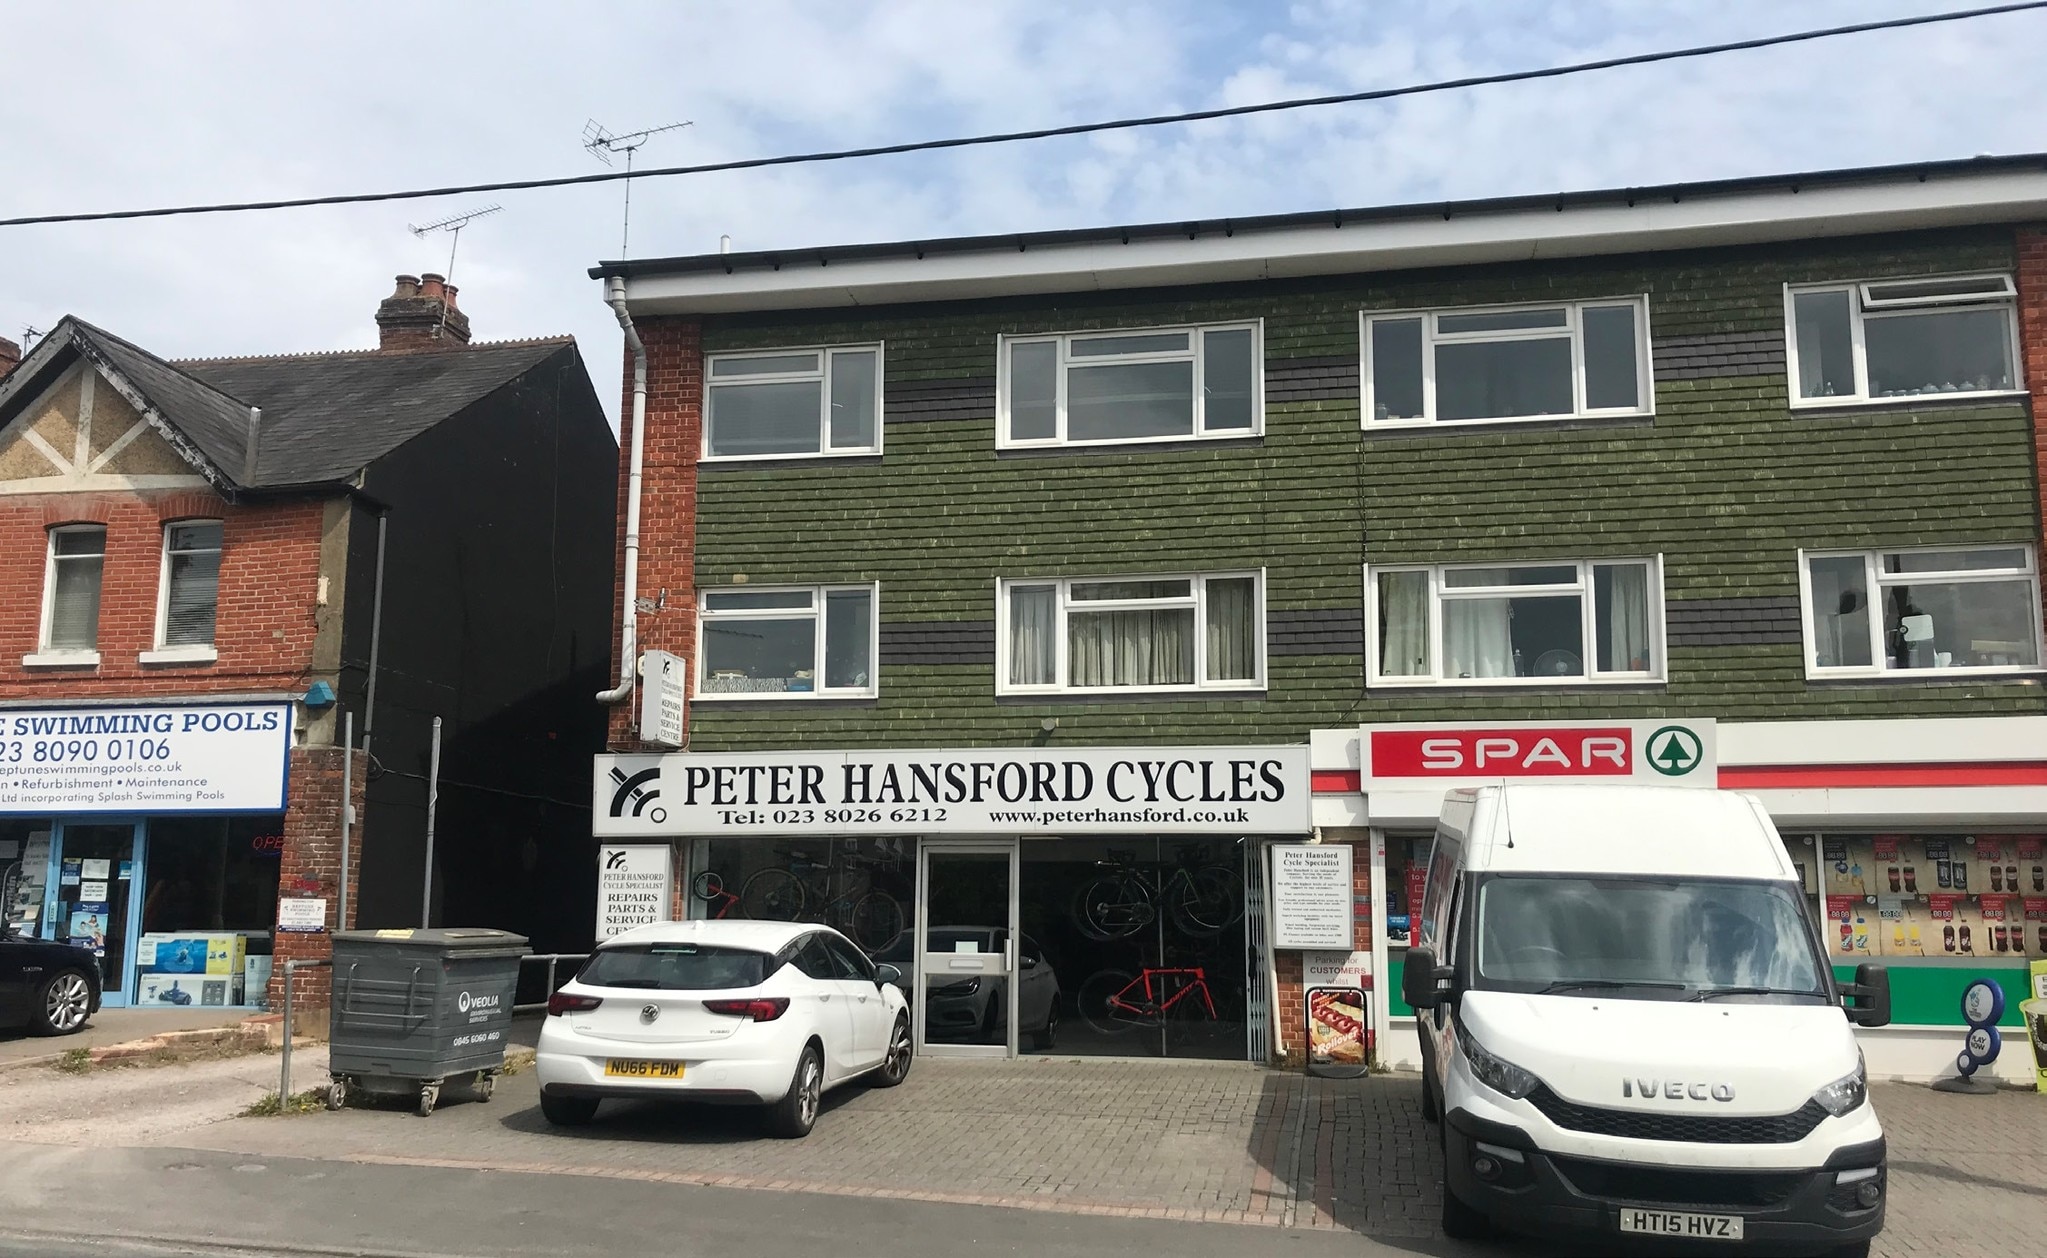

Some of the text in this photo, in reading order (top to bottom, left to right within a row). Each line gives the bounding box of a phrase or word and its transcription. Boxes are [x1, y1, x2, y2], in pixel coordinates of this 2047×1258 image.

[662, 698, 680, 711] REPAIRS
[661, 708, 680, 721] PARTS &
[13, 713, 174, 736] SWIMMING
[182, 711, 278, 733] POOLS
[660, 718, 680, 731] SERVICE
[661, 729, 679, 740] CENTRE
[33, 740, 98, 762] 8090
[107, 738, 170, 761] 0106
[1421, 736, 1626, 770] SPAR
[22, 777, 113, 789] Refurbishment
[125, 777, 207, 788] Maintenance
[684, 759, 1285, 806] PETER HANSFORD CYCLES
[2, 790, 225, 804] Ltd incorporating Splash Swimming Pools
[717, 808, 947, 825] Tel: 023 8026 6212
[989, 807, 1249, 826] www.peterhansford.co.uk
[253, 836, 284, 849] OPE
[1285, 851, 1302, 859] Peter
[1283, 859, 1339, 867] Cycle Specialist
[604, 873, 664, 881] PETER HANSFORD
[608, 893, 658, 902] REPAIRS
[608, 904, 656, 913] PARTS &
[1315, 956, 1358, 964] Parking for
[1310, 966, 1367, 975] CUSTOMERS
[471, 995, 499, 1008] VEOLIA
[453, 1035, 470, 1046] 0845
[470, 1033, 487, 1043] 6060
[1317, 1030, 1358, 1055] Rollover
[1971, 1035, 1987, 1044] PLAY
[1971, 1042, 1986, 1051] NOW
[611, 1060, 679, 1076] NU66 FDM
[1622, 1077, 1736, 1102] IVECO
[1633, 1212, 1730, 1237] HT15 HVZ
